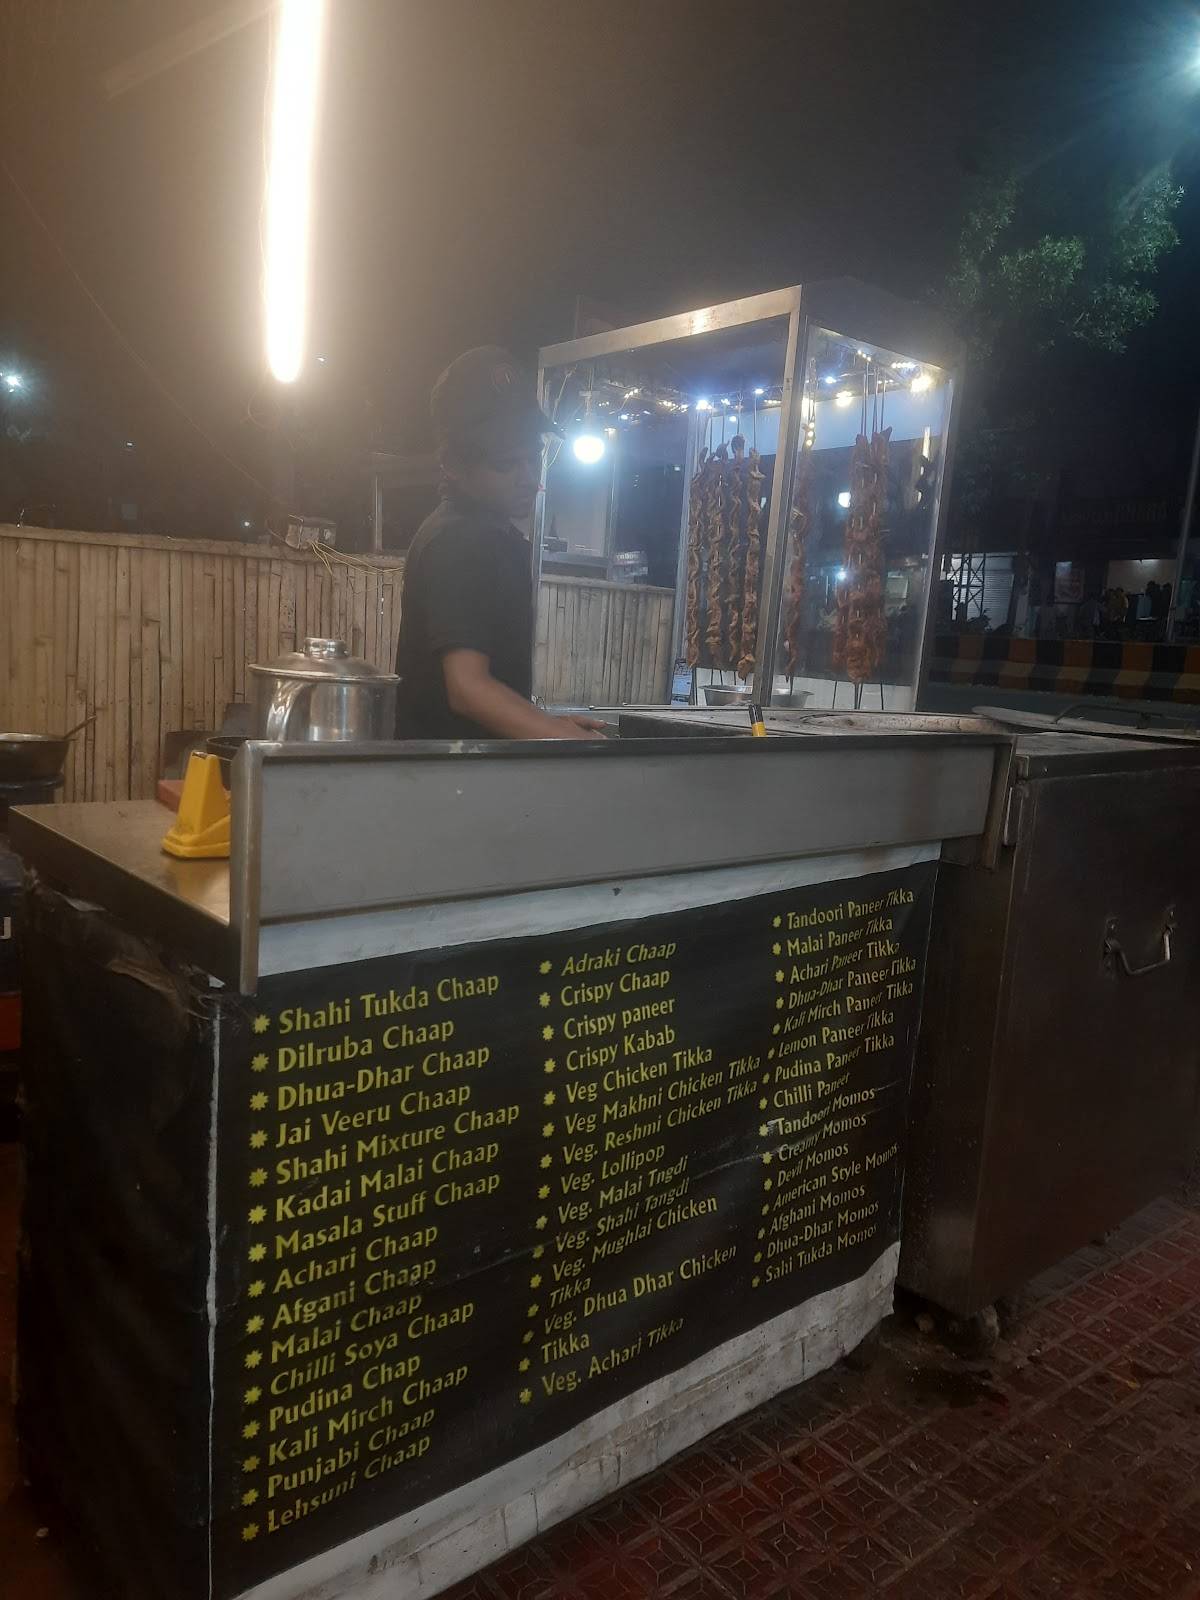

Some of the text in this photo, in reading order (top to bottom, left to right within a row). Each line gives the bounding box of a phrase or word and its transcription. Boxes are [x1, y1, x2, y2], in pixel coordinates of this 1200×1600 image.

[787, 888, 913, 930] Tandoori Paneer Tikka
[787, 917, 893, 957] Malai Paneer Tikka
[561, 942, 676, 976] Adraki Chaap
[561, 970, 671, 1007] Crispy Chaap
[788, 957, 917, 1010] Dhua-Dhar Paneer Tikka
[790, 939, 900, 984] Achari Paneer Tikka
[279, 975, 499, 1034] Shahi Tukda Chaap
[564, 998, 675, 1039] Crispy paneer
[778, 1010, 894, 1058] Lemon Paneer Tikka
[784, 982, 913, 1034] Kali Mirch Paneer Tikka
[278, 1020, 454, 1073] Dilruba Chaap
[566, 1025, 676, 1071] Crispy Kabab
[566, 1046, 713, 1103] Veg Chicken Tikka
[775, 1033, 894, 1082] Pudina Paneer Tikka
[278, 1046, 490, 1111] Dhua-Dhar Chaap
[565, 1055, 761, 1135] Veg Makhni Chicken Tikka
[774, 1073, 850, 1108] Chilli Paneer
[276, 1085, 471, 1148] Jai Veeru Chaap
[563, 1079, 757, 1165] Veg. Reshmi Chicken Tikka
[774, 1088, 875, 1136] Tandoori Momos
[778, 1113, 868, 1161] Creamy Momos
[276, 1105, 520, 1185] Shahi Mixture Chaap
[561, 1144, 665, 1194] Veg. Lollipop
[777, 1143, 849, 1187] Devil Momos
[276, 1142, 499, 1222] Kadai Malai Chaap
[558, 1200, 592, 1224] Veg.
[600, 1176, 642, 1208] Malai
[773, 1142, 898, 1211] American Style Momos
[275, 1174, 500, 1259] Masala Stuff Chaap
[552, 1197, 717, 1281] Veg. Mughlai Chicken
[555, 1177, 690, 1252] Veg. Shahi Tangdi
[767, 1200, 879, 1259] Dhua-Dhar Momos
[770, 1184, 865, 1235] Afghani Momos
[273, 1226, 438, 1293] Achari Chaap
[765, 1223, 878, 1283] Sahi Tukda Momos
[272, 1259, 436, 1330] Afgani Chaap
[544, 1245, 736, 1334] Veg. Dhua Dhar Chicken
[550, 1277, 591, 1308] Tikka
[270, 1302, 474, 1395] Chilli Soya Chaap
[271, 1294, 422, 1364] Malai Chaap
[541, 1331, 590, 1364] Tikka
[541, 1317, 684, 1396] Veg. Achari Tikka
[269, 1355, 421, 1432] Pudina Chap
[269, 1365, 469, 1466] Kali Mirch Chaap
[267, 1408, 435, 1499] Punjabi Chaap
[268, 1435, 431, 1534] Lehsuni Chaap
